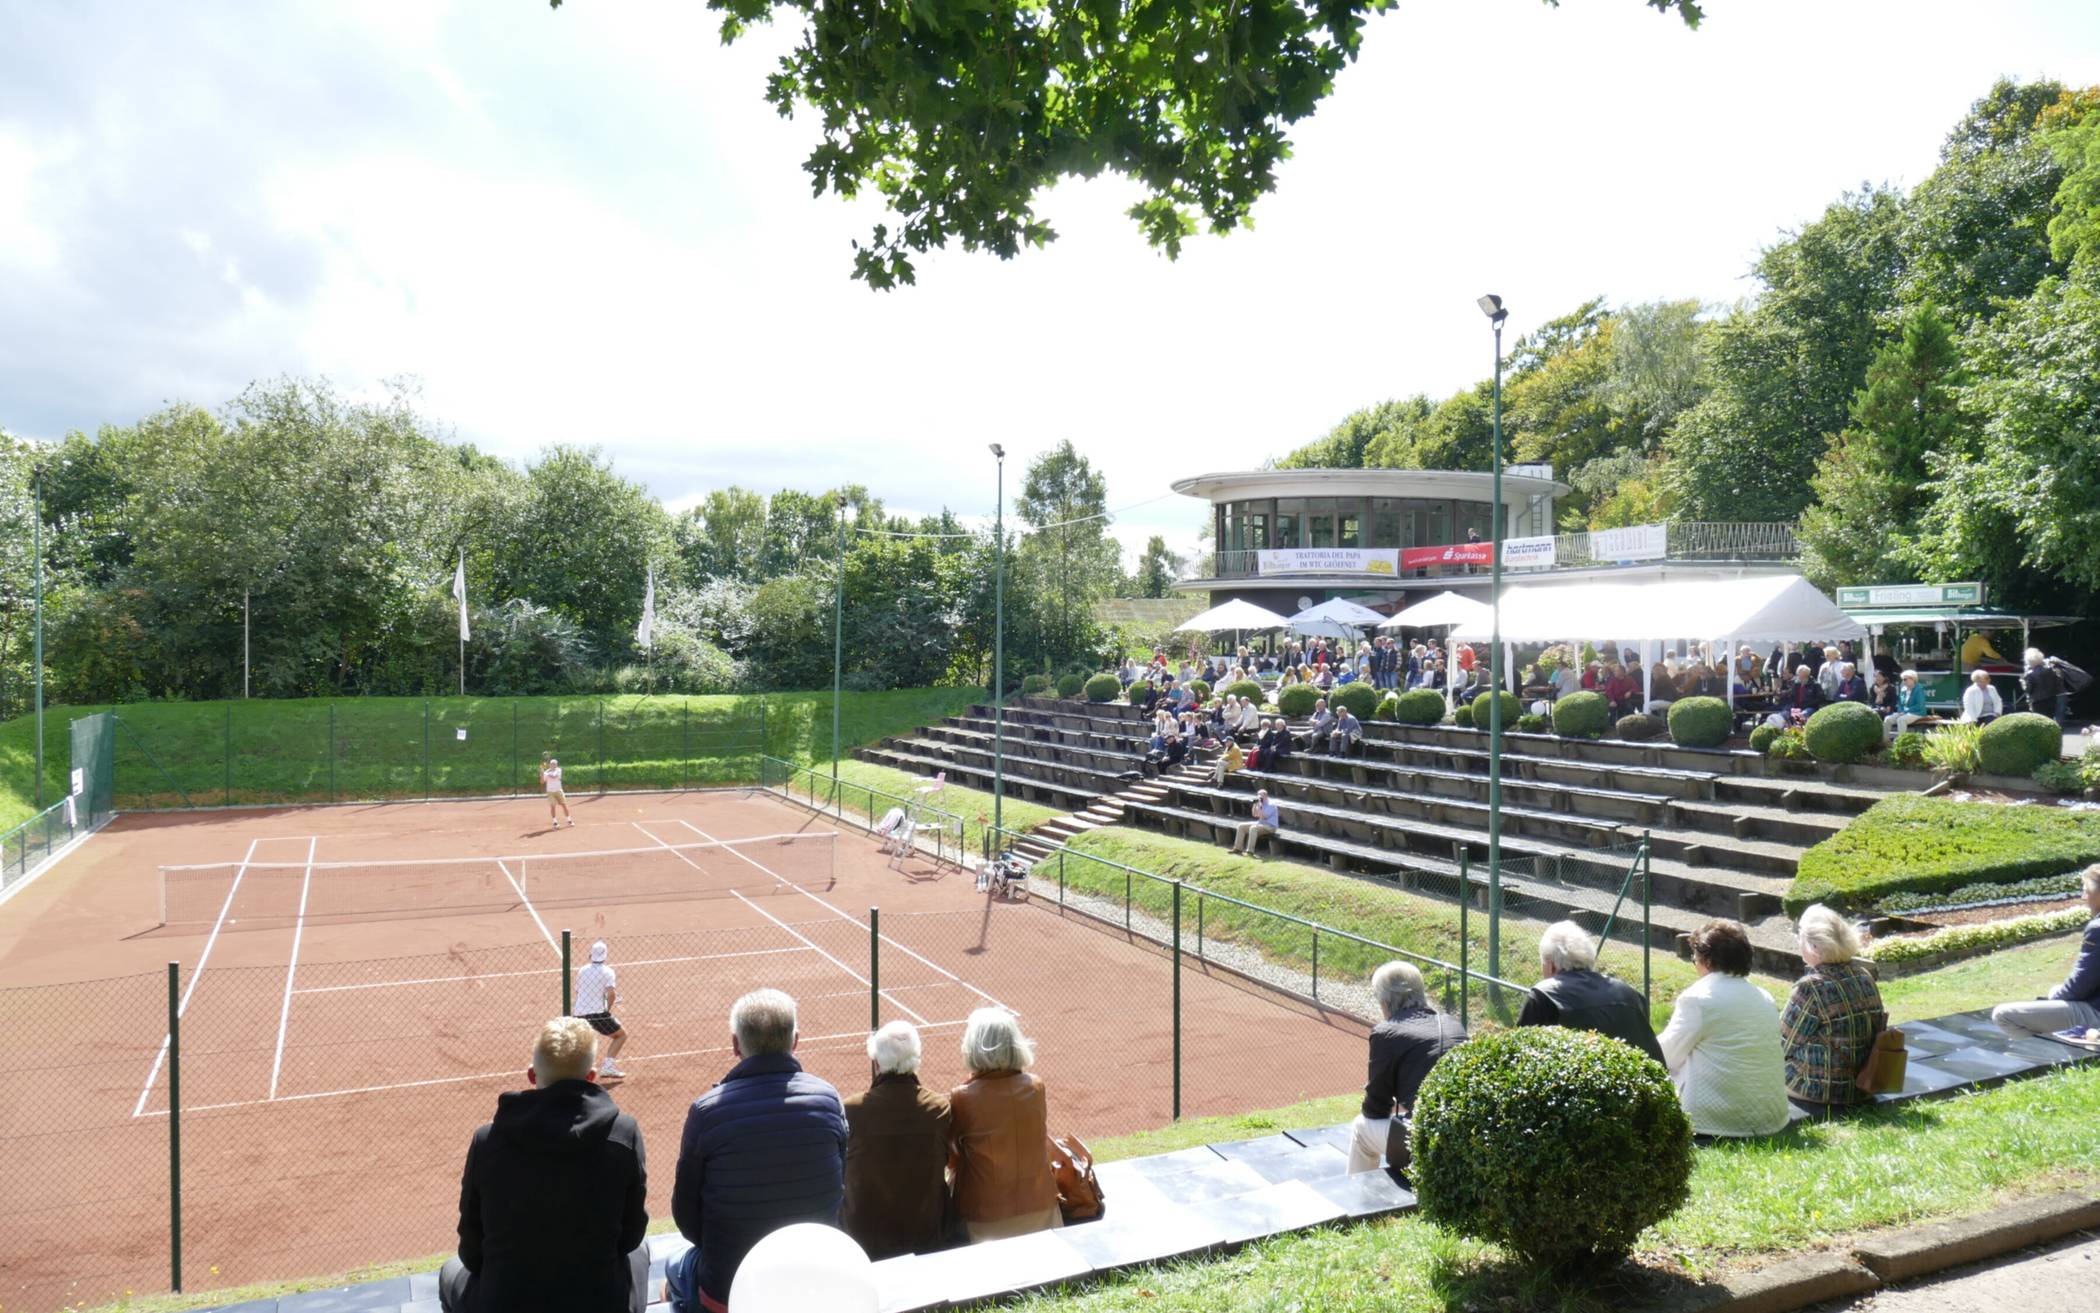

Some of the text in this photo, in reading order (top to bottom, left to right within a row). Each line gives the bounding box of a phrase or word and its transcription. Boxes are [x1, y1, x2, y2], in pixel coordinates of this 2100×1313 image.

[1296, 551, 1361, 559] TRATTORIA DEL PAPA
[1454, 551, 1487, 561] Sparkasse
